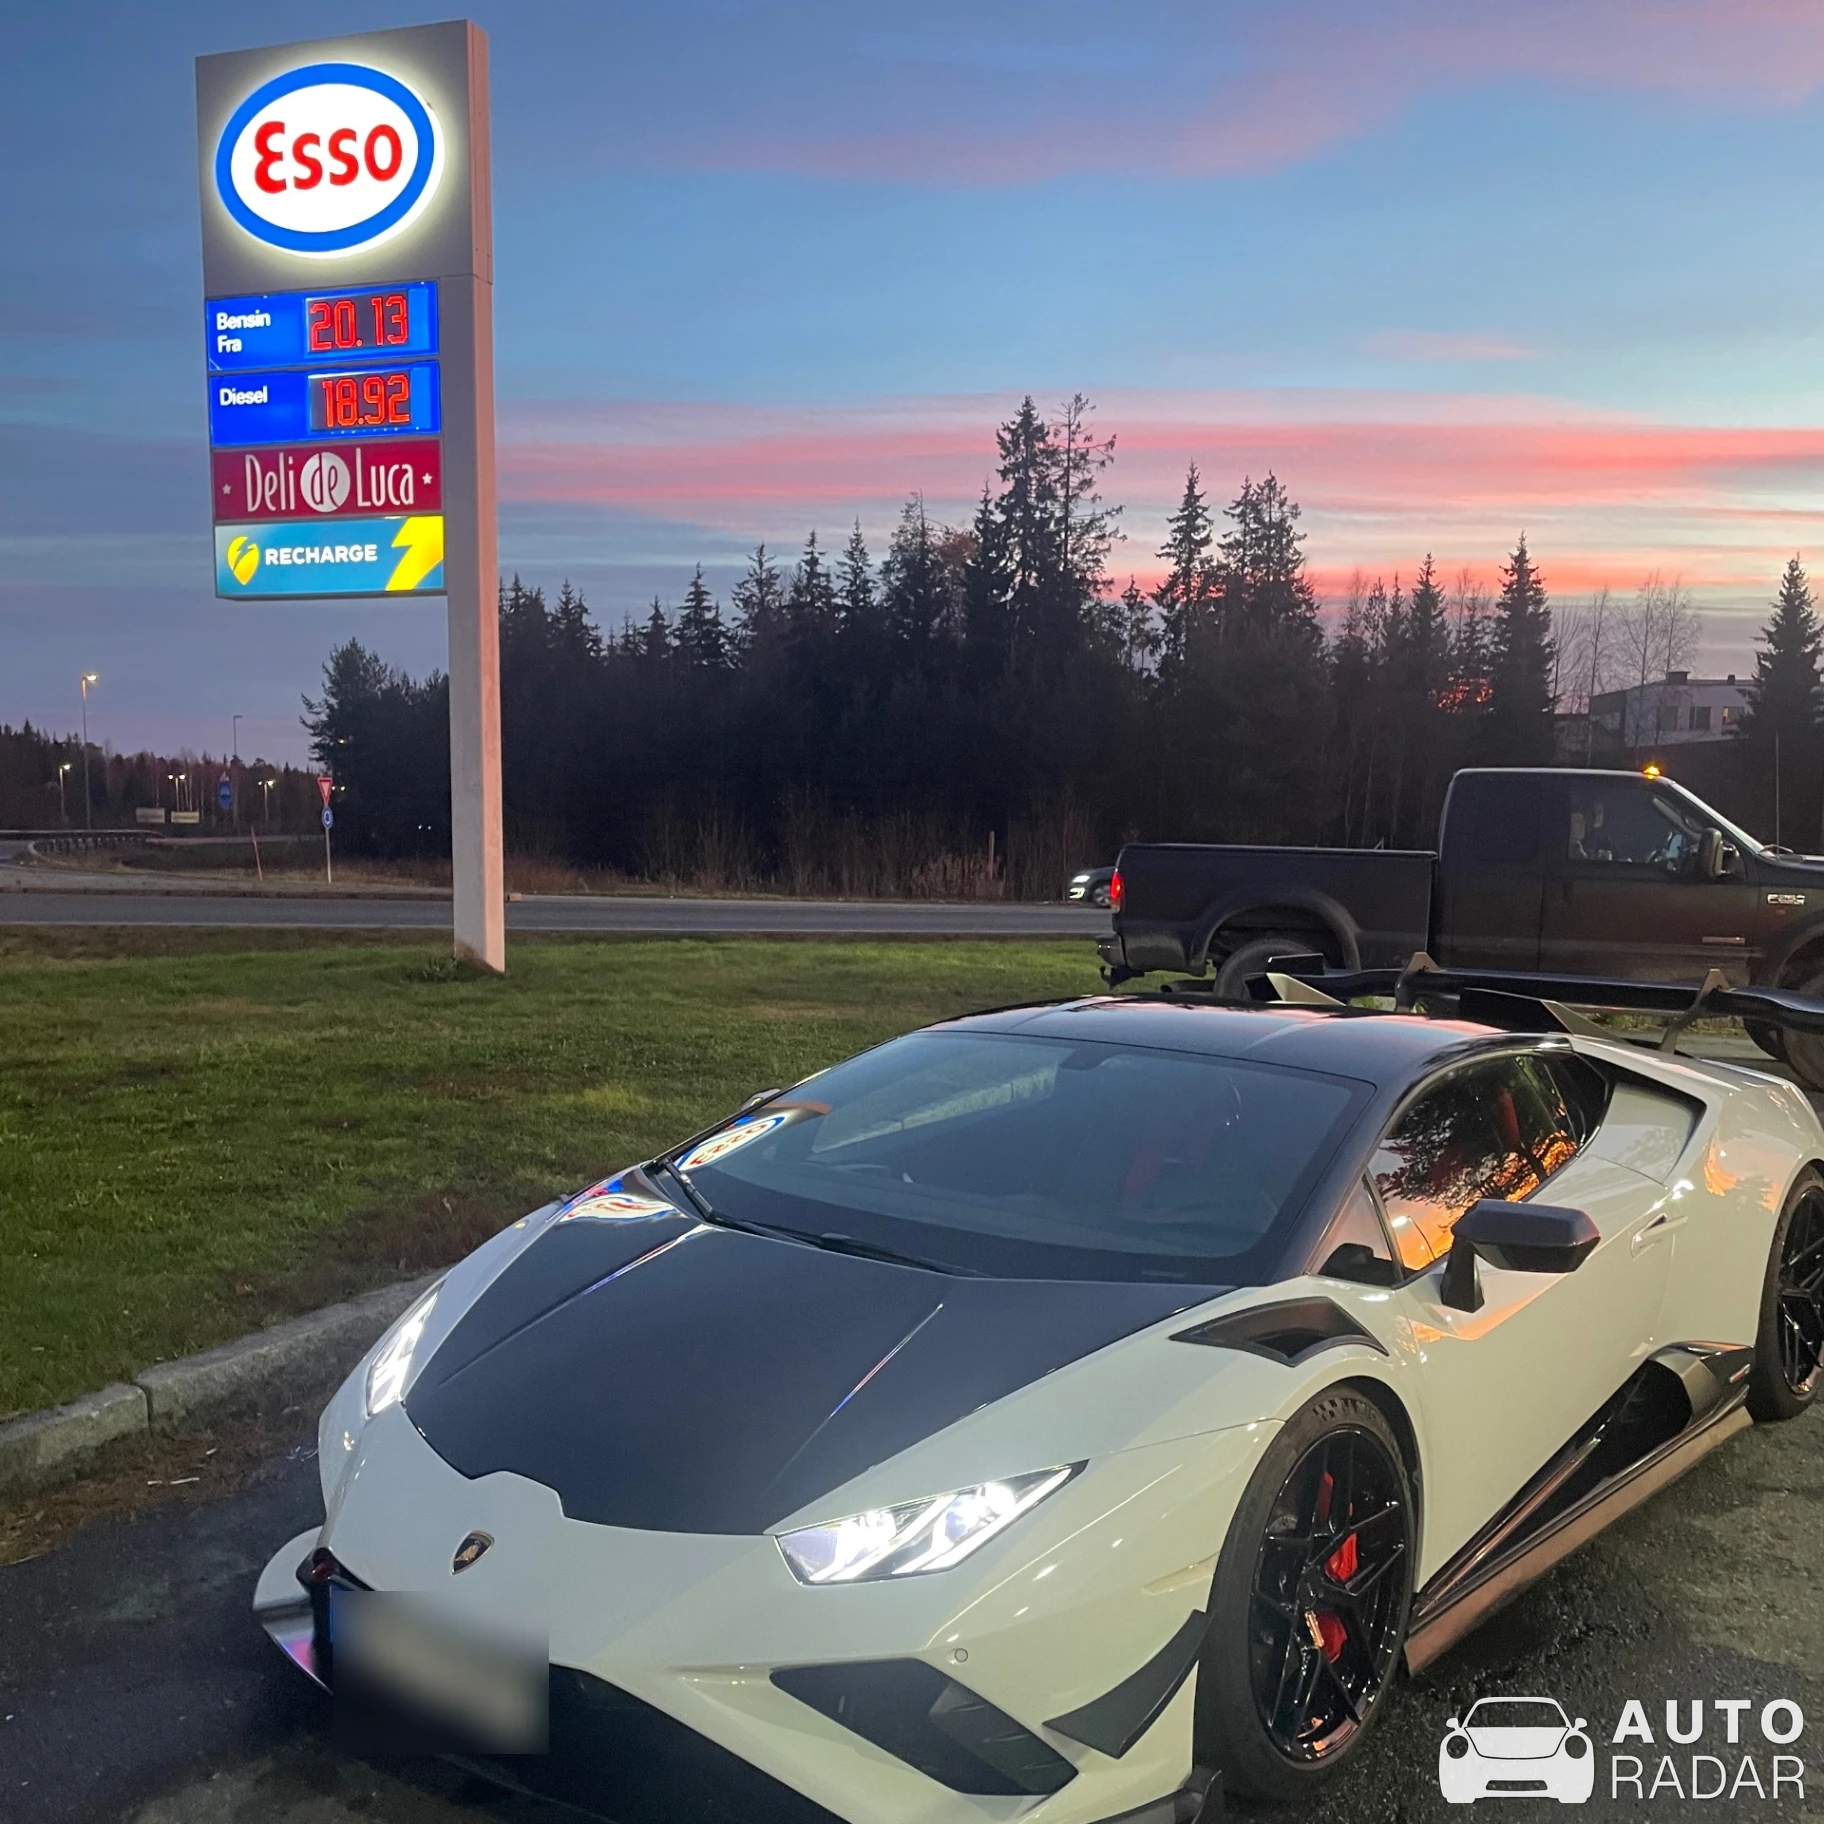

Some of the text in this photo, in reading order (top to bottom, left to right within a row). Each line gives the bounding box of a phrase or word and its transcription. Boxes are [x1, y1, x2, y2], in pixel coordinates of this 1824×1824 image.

[216, 310, 271, 330] Bensin
[309, 295, 408, 350] 20.13
[217, 335, 242, 353] Fra
[219, 386, 268, 406] Diesel
[322, 374, 410, 427] 18.92
[245, 447, 414, 512] Deli de Luca
[265, 545, 378, 565] RECHARGE
